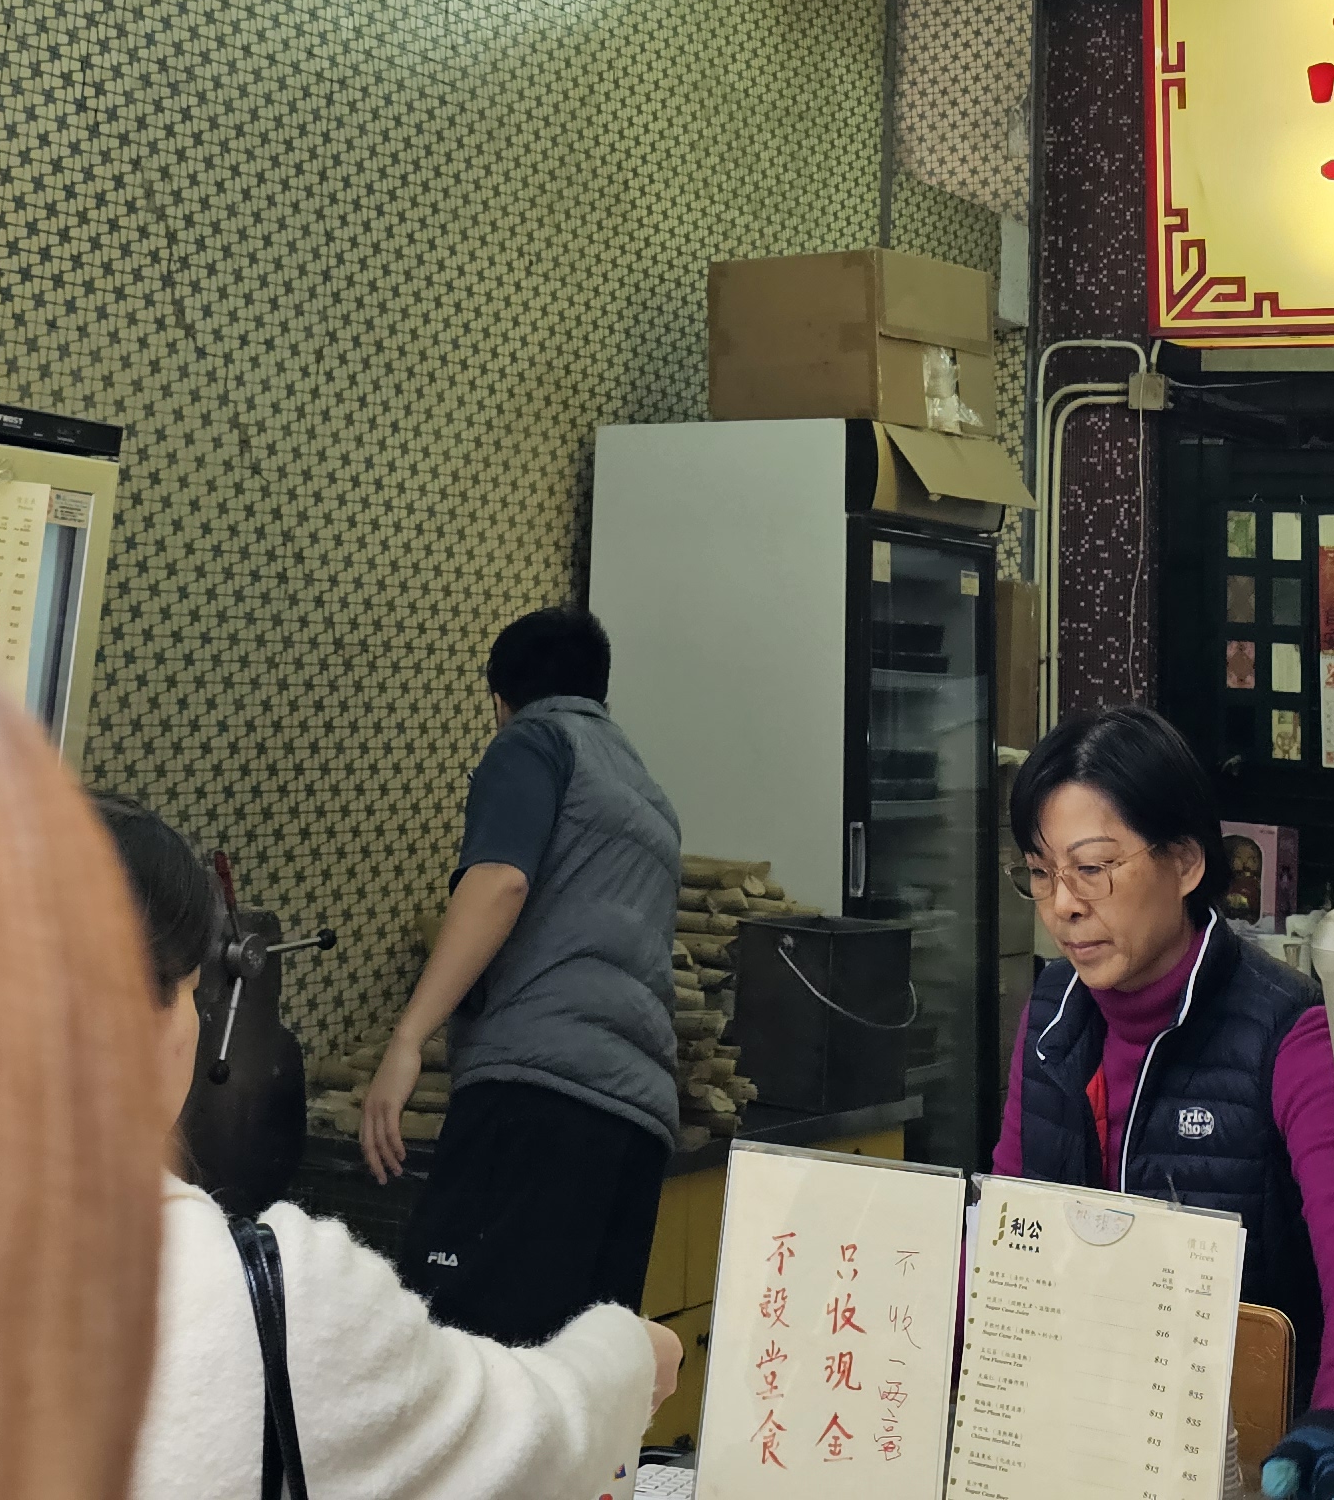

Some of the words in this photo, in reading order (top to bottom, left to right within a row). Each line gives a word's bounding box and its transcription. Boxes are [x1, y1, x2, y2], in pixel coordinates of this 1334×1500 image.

[1178, 1123, 1213, 1135] Shoes
[427, 1251, 458, 1267] FILA
[1189, 1252, 1214, 1262] Prices
[1162, 1283, 1174, 1291] Cup
[985, 1304, 1000, 1312] Sugar
[1158, 1303, 1172, 1312] $16
[1195, 1309, 1210, 1320] $43
[982, 1329, 997, 1337] Sugar
[1155, 1329, 1169, 1339] $16
[1193, 1336, 1208, 1347] $43
[750, 1232, 797, 1470] 不設堂食
[1154, 1356, 1168, 1366] $13
[1191, 1363, 1206, 1373] $35
[1151, 1383, 1166, 1393] $13
[1188, 1389, 1204, 1400] $35
[987, 1409, 1001, 1417] Plum
[1149, 1409, 1163, 1419] $13
[1186, 1416, 1201, 1427] $35
[971, 1432, 990, 1441] Chinese
[991, 1437, 1010, 1446] Herbal
[1011, 1440, 1021, 1448] Tea
[1147, 1436, 1161, 1447] $13
[1184, 1444, 1199, 1455] $35
[1145, 1463, 1159, 1474] $13
[1182, 1471, 1197, 1482] $35
[965, 1487, 980, 1495] Sugar
[1142, 1491, 1157, 1500] $13
